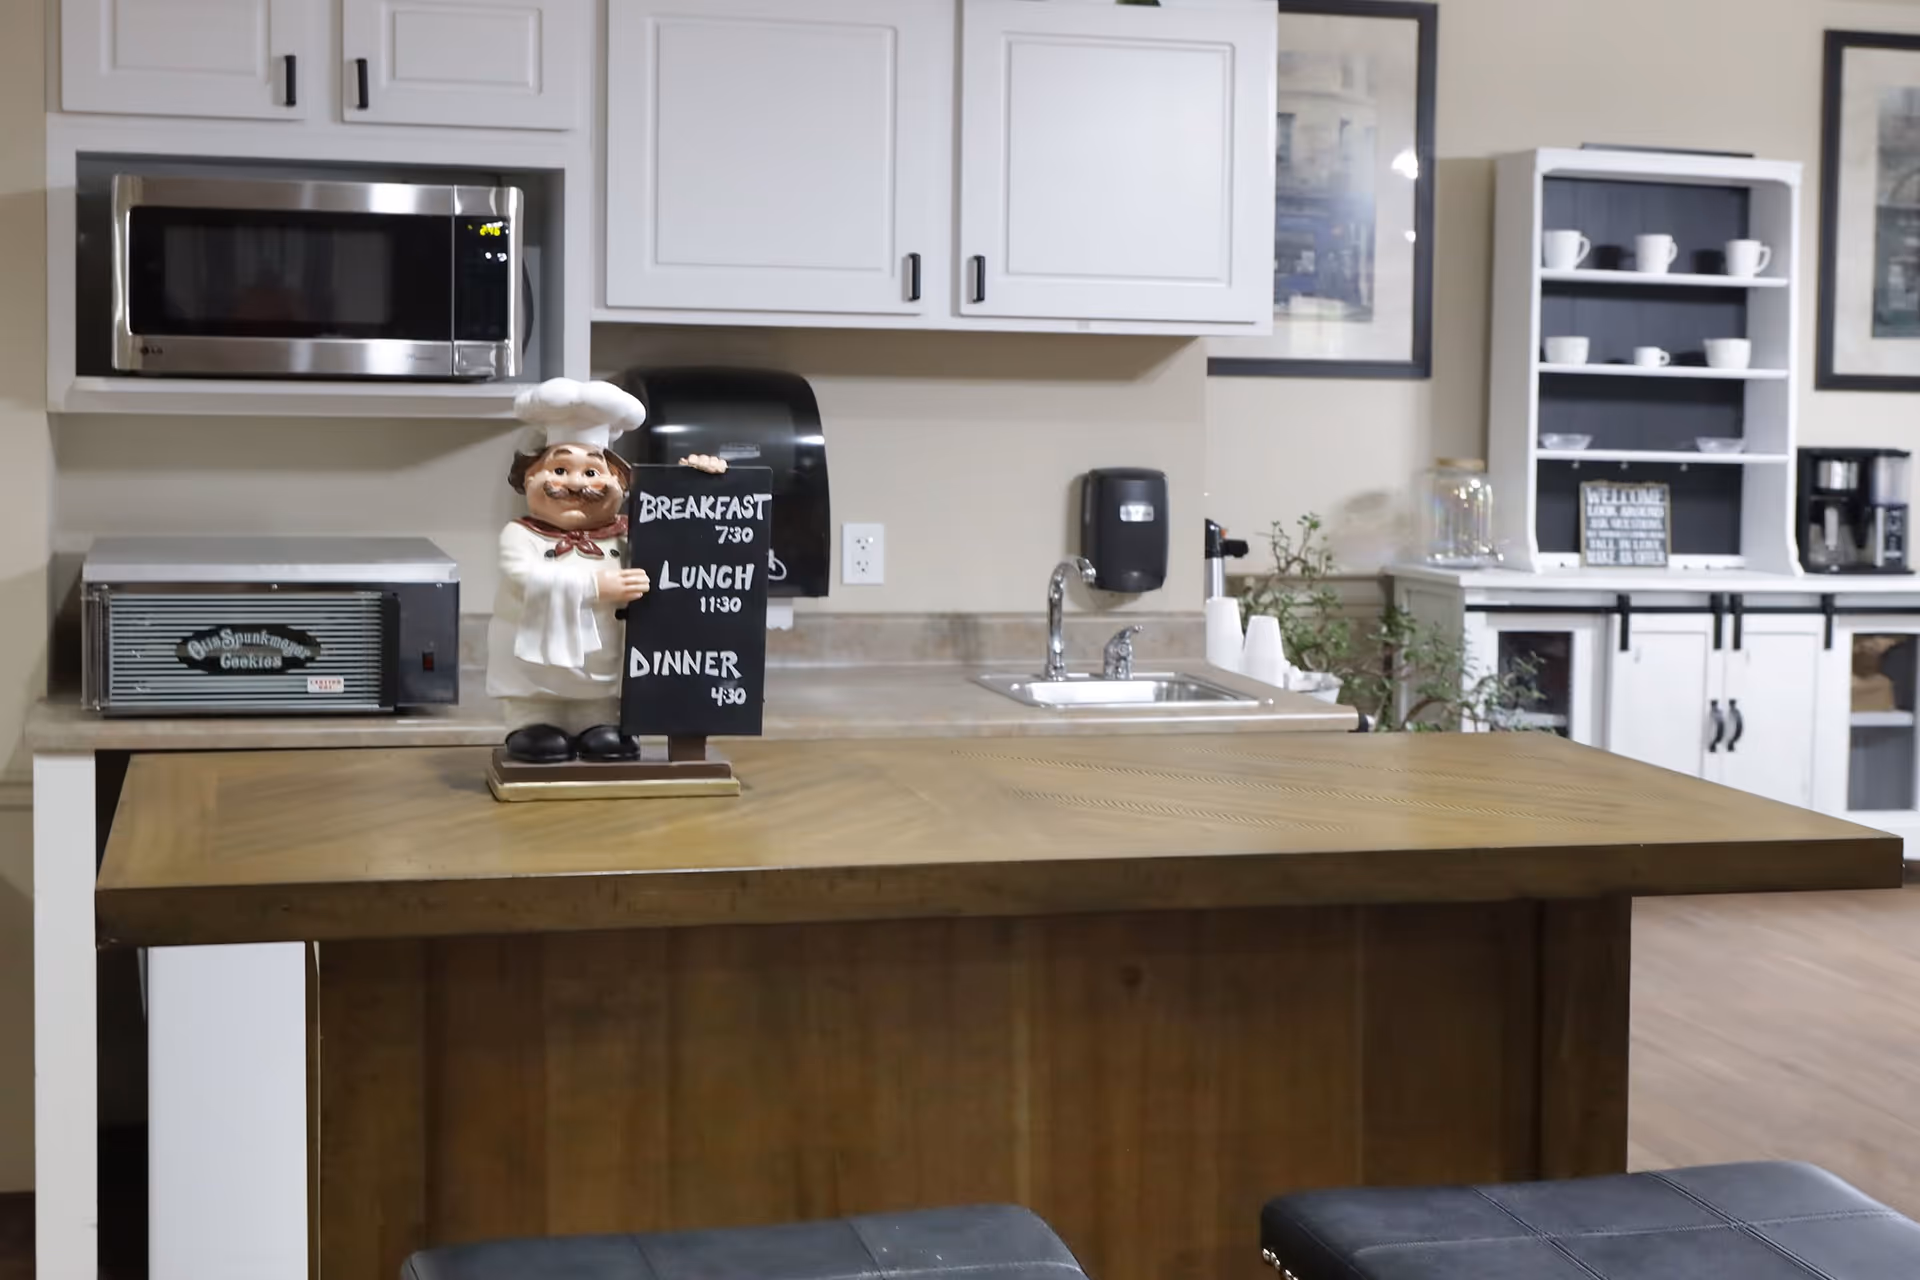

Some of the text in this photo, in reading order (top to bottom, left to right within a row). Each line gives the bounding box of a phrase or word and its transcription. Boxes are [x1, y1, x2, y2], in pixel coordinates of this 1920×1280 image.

[639, 491, 773, 523] BREAKFAST
[715, 525, 754, 544] 7:30
[659, 560, 755, 591] LUNCH
[700, 596, 742, 613] 11:30
[629, 646, 743, 679] DINNER
[711, 687, 747, 707] 4:30
